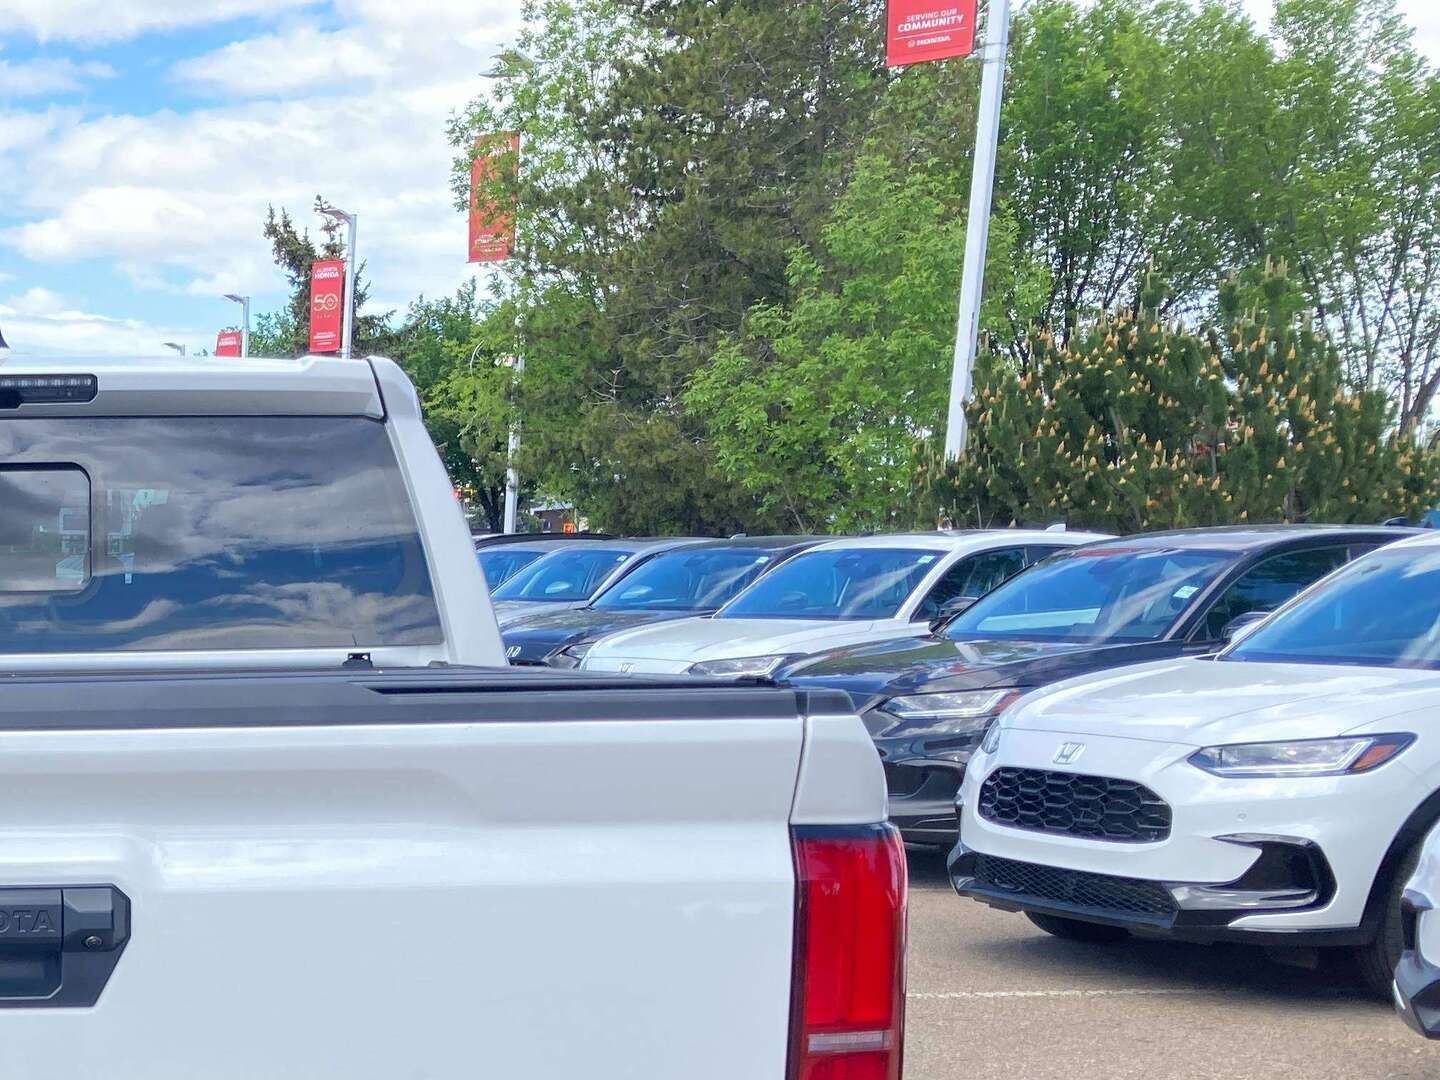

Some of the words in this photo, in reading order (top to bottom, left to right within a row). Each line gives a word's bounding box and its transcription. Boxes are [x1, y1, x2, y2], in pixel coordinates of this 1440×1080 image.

[941, 8, 958, 17] OUR
[897, 14, 964, 33] COMMUNITY
[314, 271, 339, 279] HONDA
[313, 293, 339, 312] 50
